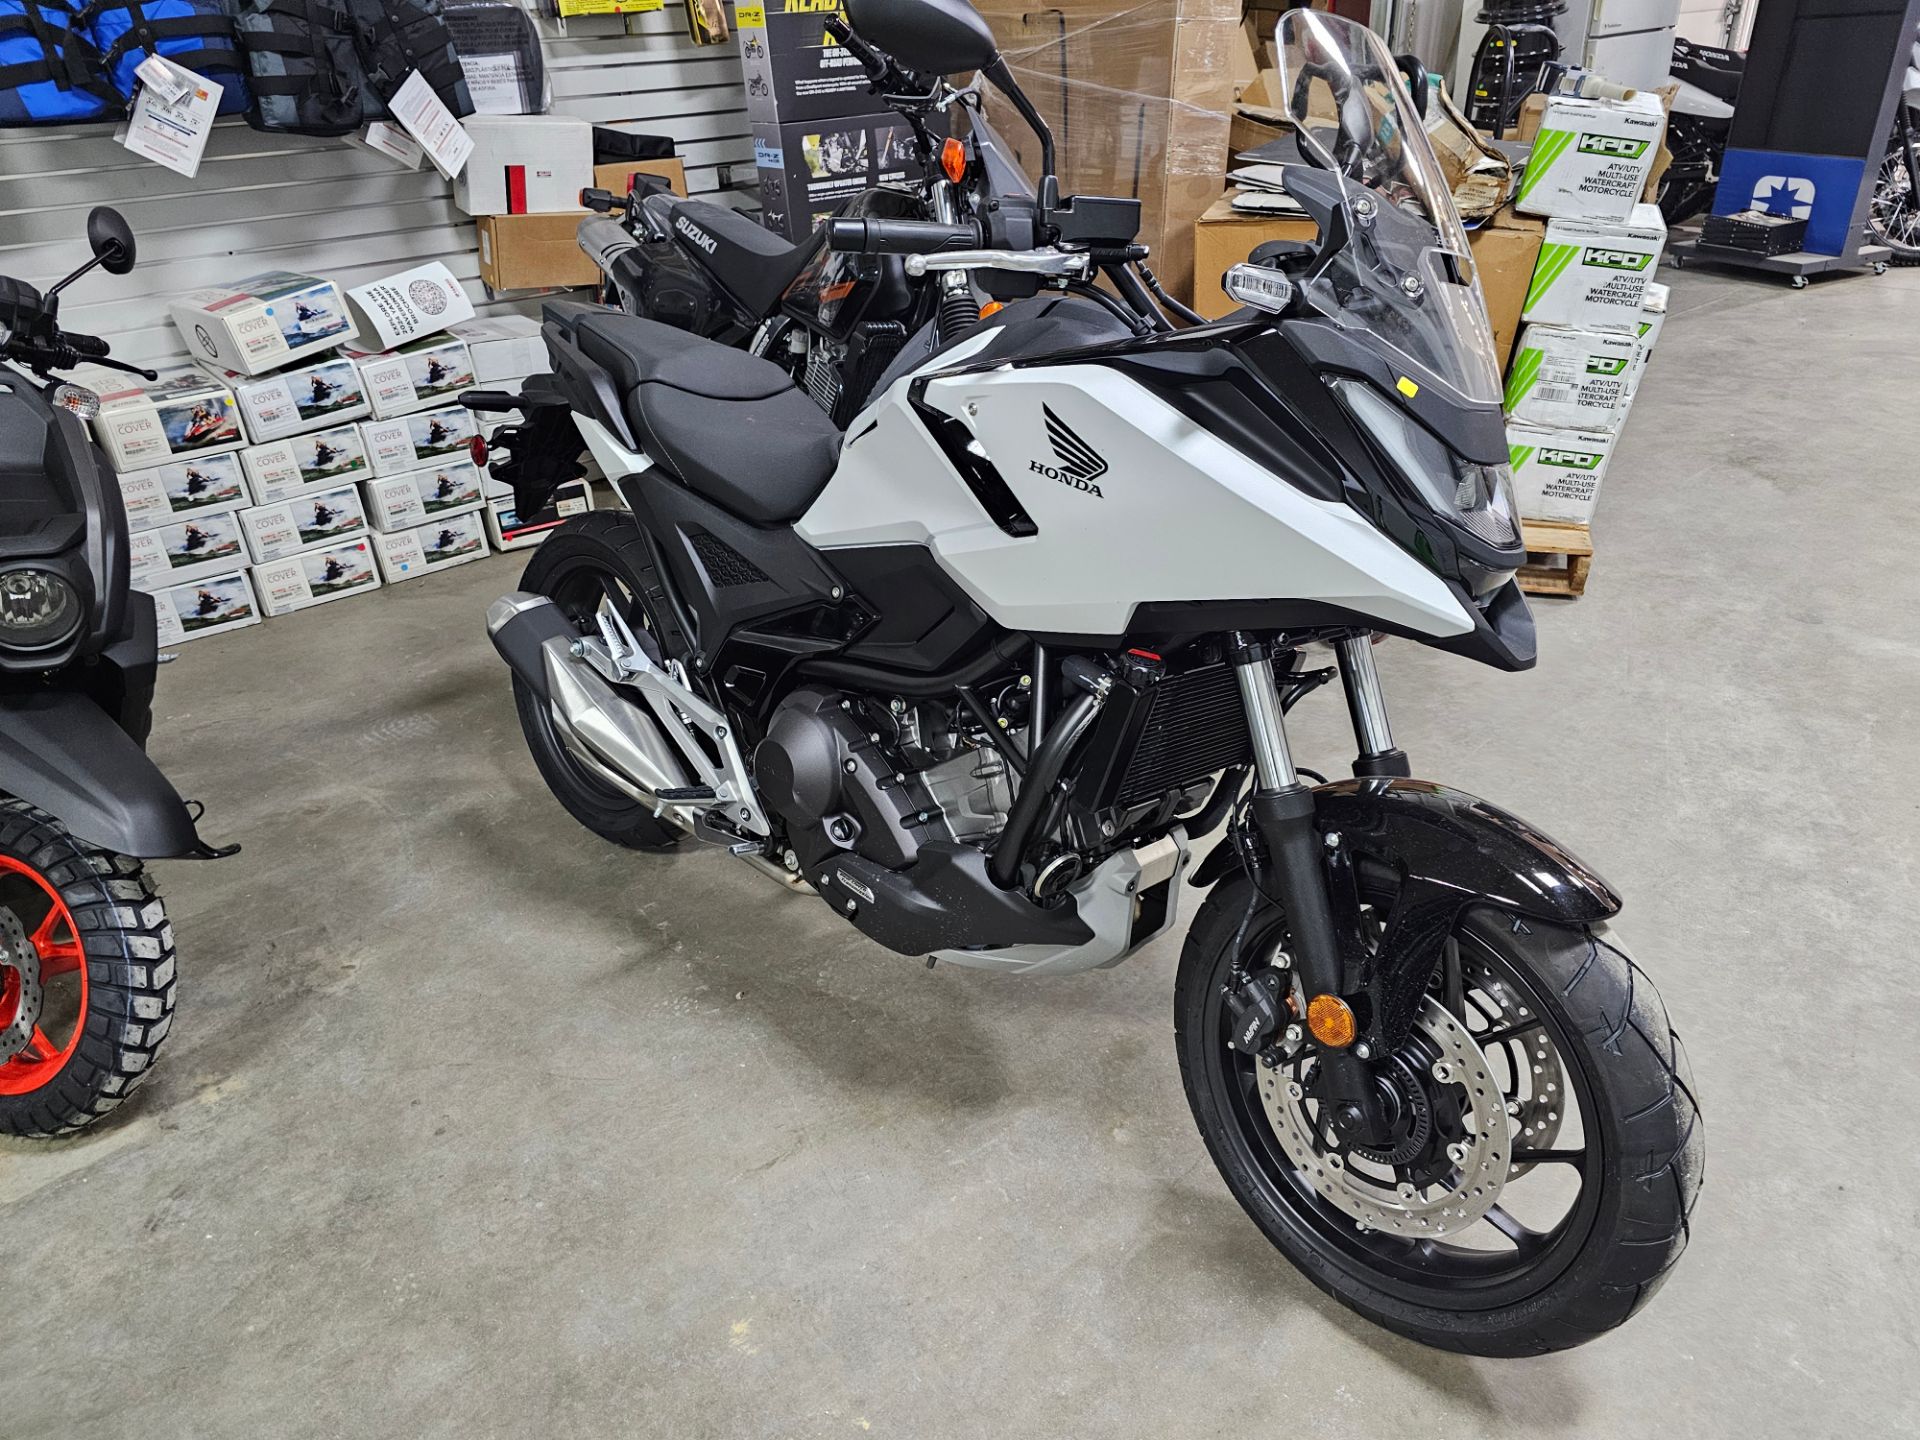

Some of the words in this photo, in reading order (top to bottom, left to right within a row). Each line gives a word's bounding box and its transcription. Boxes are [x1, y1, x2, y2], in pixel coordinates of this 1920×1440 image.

[1699, 49, 1730, 62] HONDA
[1624, 117, 1658, 128] Kawasaki
[1608, 163, 1643, 174] ATV/UTV
[1584, 176, 1638, 190] WATERCRAFT
[1597, 171, 1640, 182] MULTI-USE
[1578, 184, 1634, 198] MOTORCYCLE
[675, 216, 718, 255] SUZUKI
[1627, 232, 1661, 242] Kawasaki
[1613, 275, 1648, 284] ATV/UTV
[365, 290, 378, 303] THE
[372, 287, 396, 313] YAMAHA
[1590, 288, 1643, 300] WATERCRAFT
[389, 286, 419, 324] BROCHURE
[1585, 295, 1640, 308] MOTORCYCLE
[238, 317, 269, 335] COVER
[378, 303, 400, 336] EXPLORE
[395, 315, 408, 334] 2024
[1603, 338, 1634, 348] Kawasaki
[375, 371, 401, 384] COVER
[1589, 379, 1623, 389] ATV/UTV
[1580, 386, 1620, 396] MULTI-USE
[254, 391, 283, 405] COVER
[1578, 393, 1618, 403] TERCRAFT
[1577, 400, 1616, 410] TORCYCLE
[118, 421, 152, 435] COVER
[375, 431, 402, 442] COVER
[1578, 435, 1609, 444] Kawasaki
[256, 454, 288, 468] COVER
[1028, 460, 1104, 499] HONDA
[1558, 478, 1596, 489] MULTI-USE
[1566, 473, 1599, 482] ATV/UTV
[385, 486, 411, 499] COVER
[1542, 490, 1592, 501] MOTORCYCLE
[1546, 484, 1594, 495] WATERCRAFT
[255, 516, 285, 530] COVER
[130, 537, 153, 550] OVER
[386, 538, 413, 551] COVER
[267, 570, 297, 584] COVER
